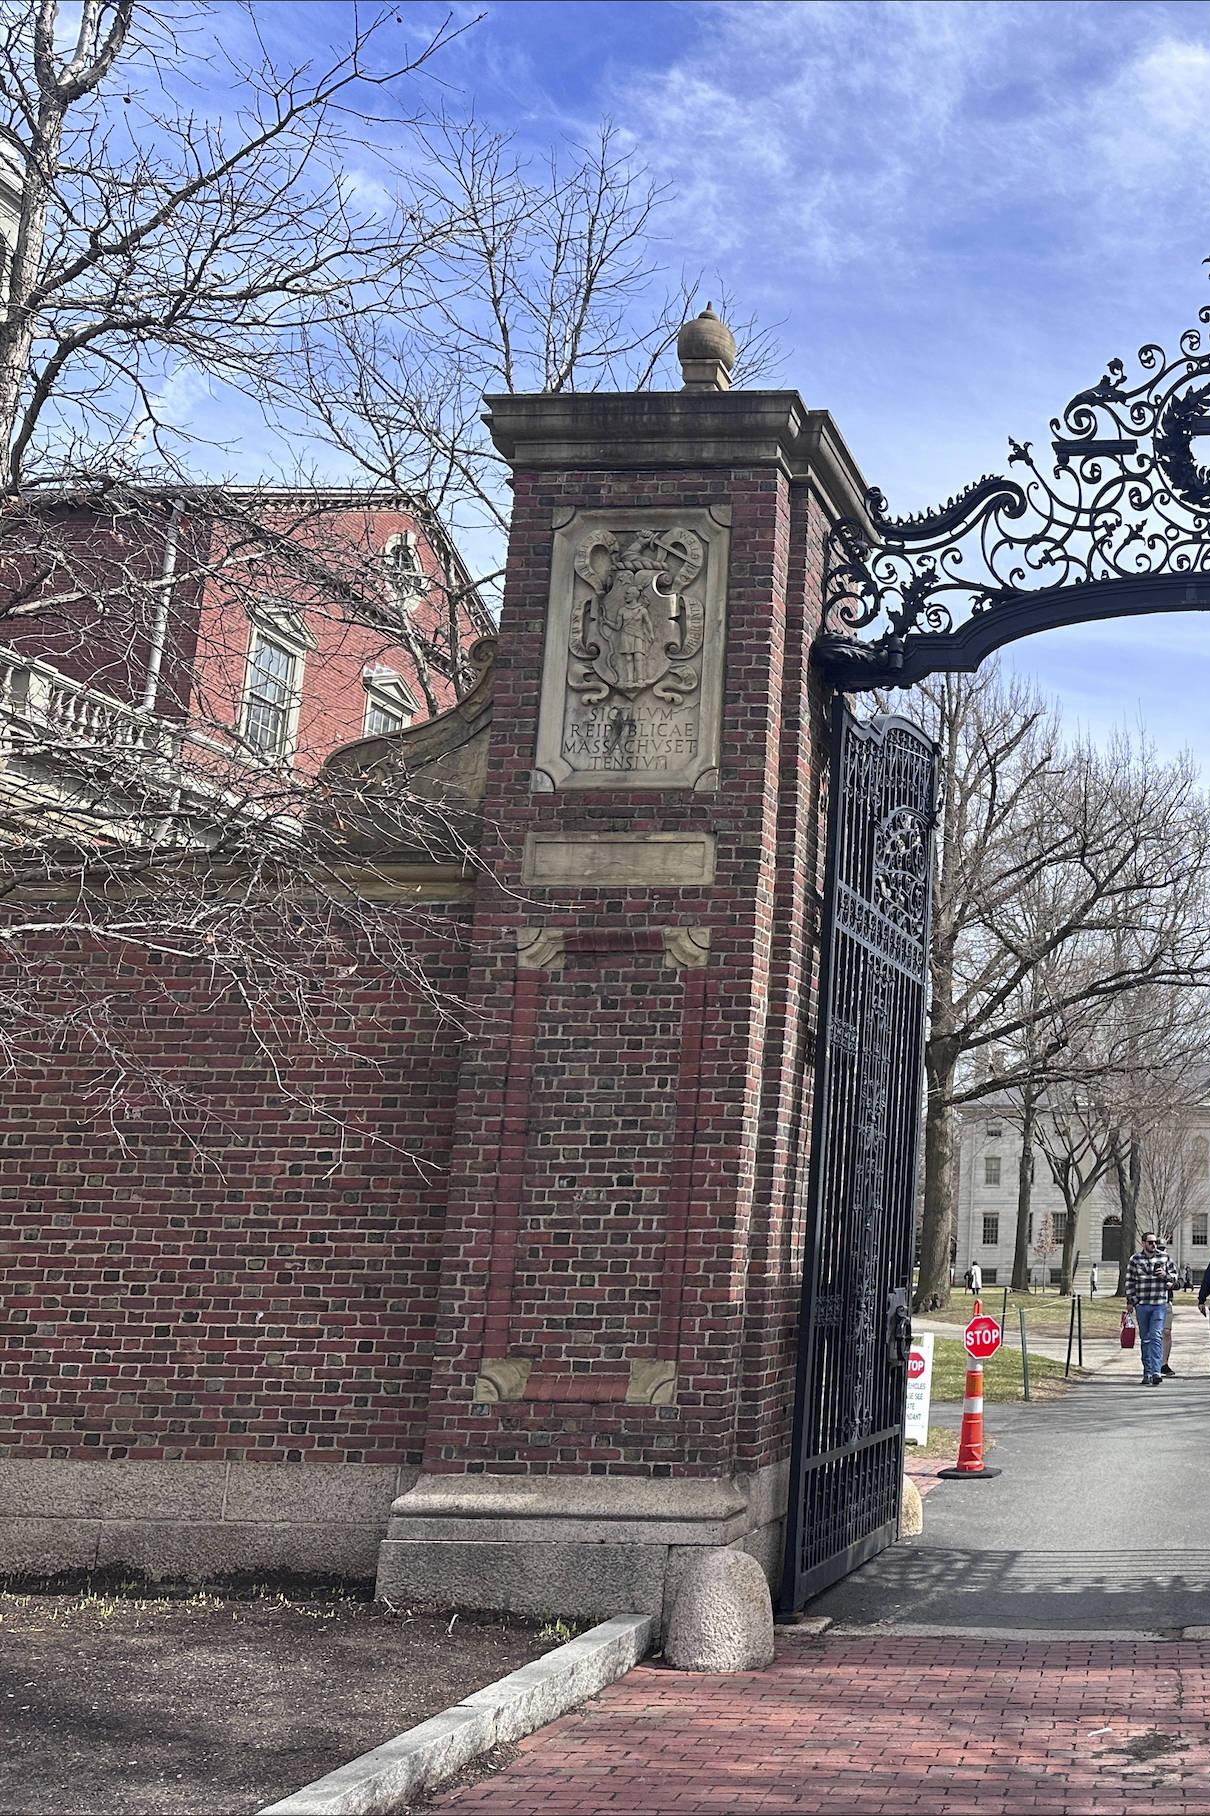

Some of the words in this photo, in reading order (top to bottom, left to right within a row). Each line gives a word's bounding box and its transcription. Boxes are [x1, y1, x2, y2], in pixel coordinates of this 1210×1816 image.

[564, 739, 697, 754] MASSACHVSET
[966, 1329, 999, 1346] STOP
[907, 1360, 924, 1371] TOP
